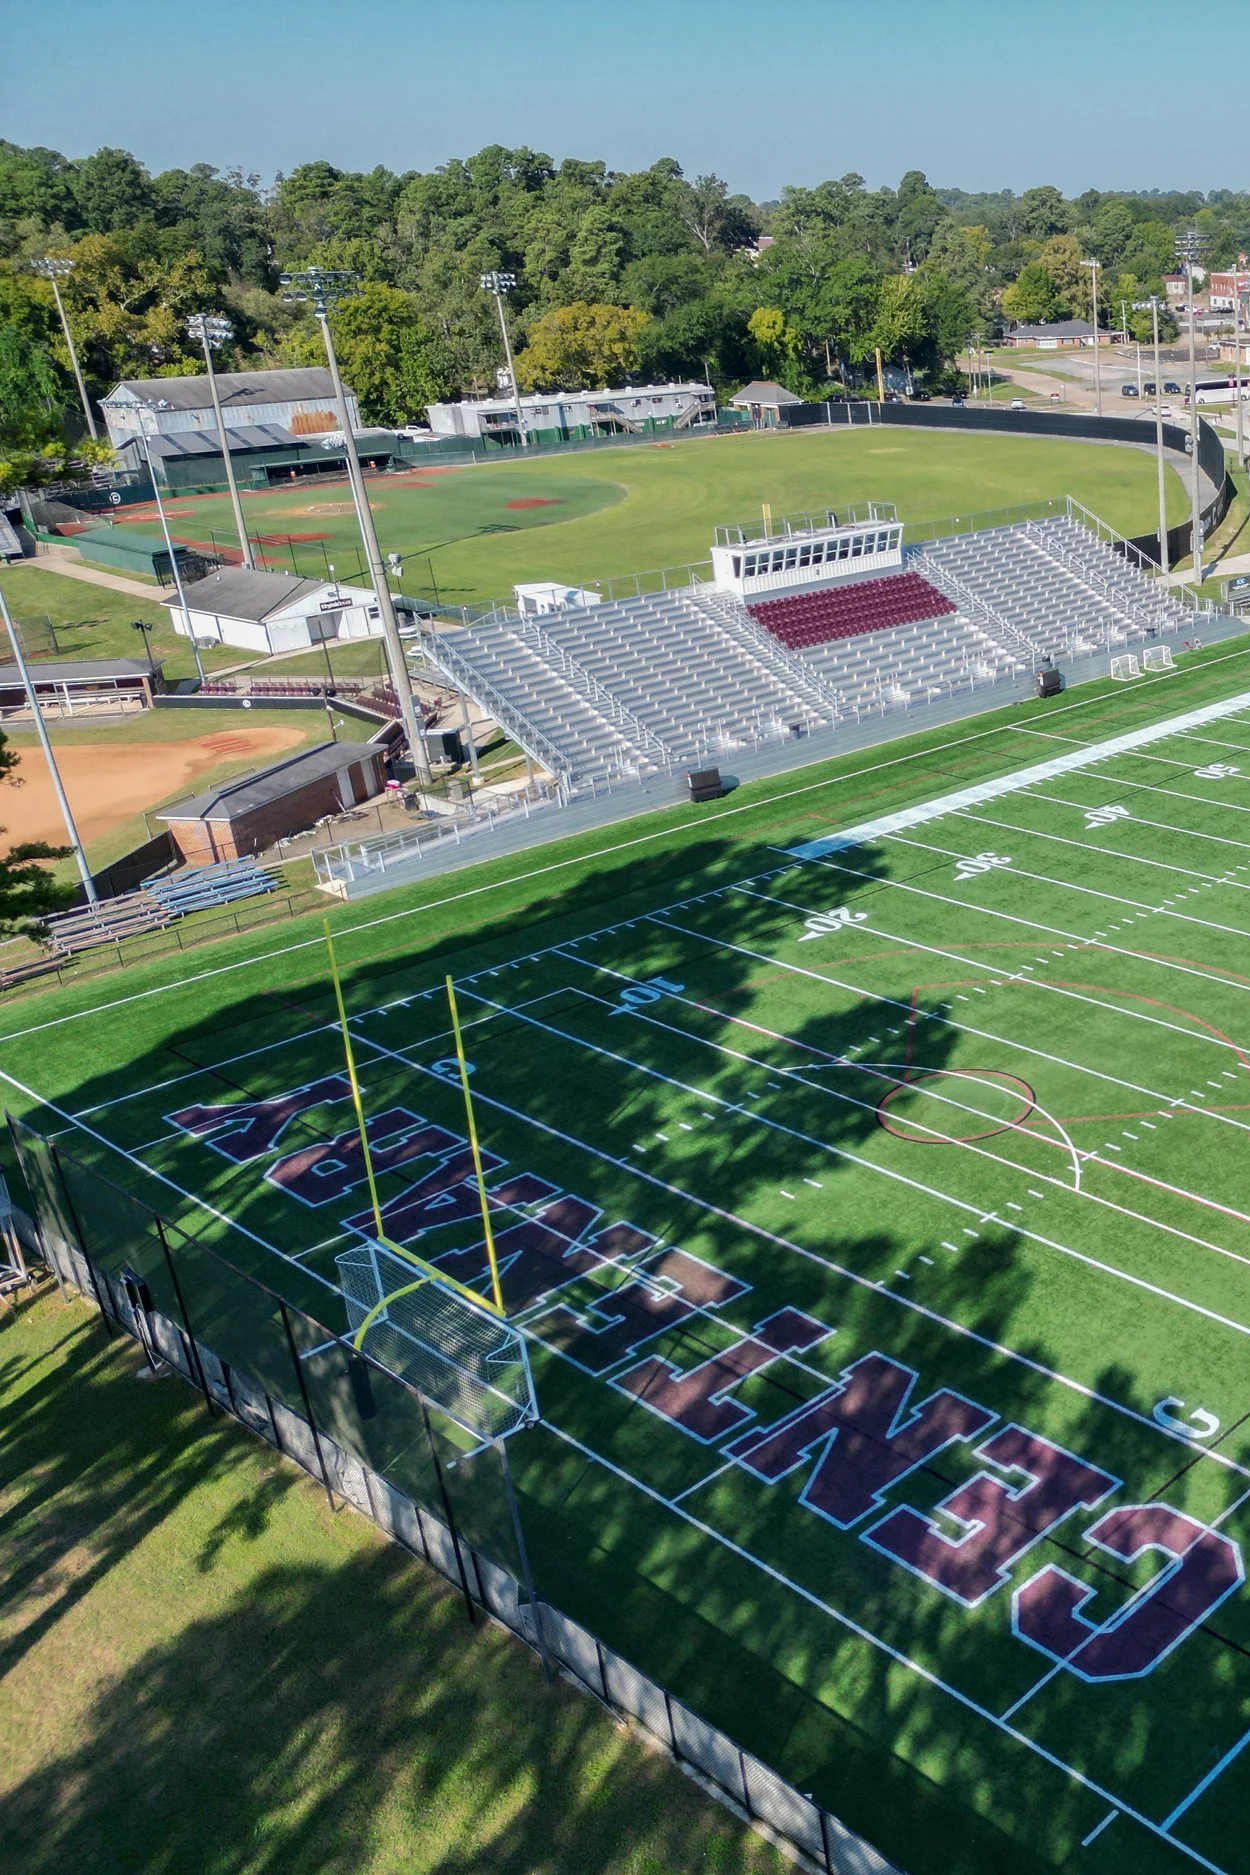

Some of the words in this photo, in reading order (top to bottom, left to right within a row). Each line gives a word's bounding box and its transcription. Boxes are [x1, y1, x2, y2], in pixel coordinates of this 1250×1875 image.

[1193, 764, 1240, 779] 50
[1084, 804, 1131, 823] 40
[954, 852, 1012, 873] 30
[804, 907, 868, 933] 20
[620, 976, 686, 1004] 10
[163, 1076, 1246, 1681] CENTENARY
